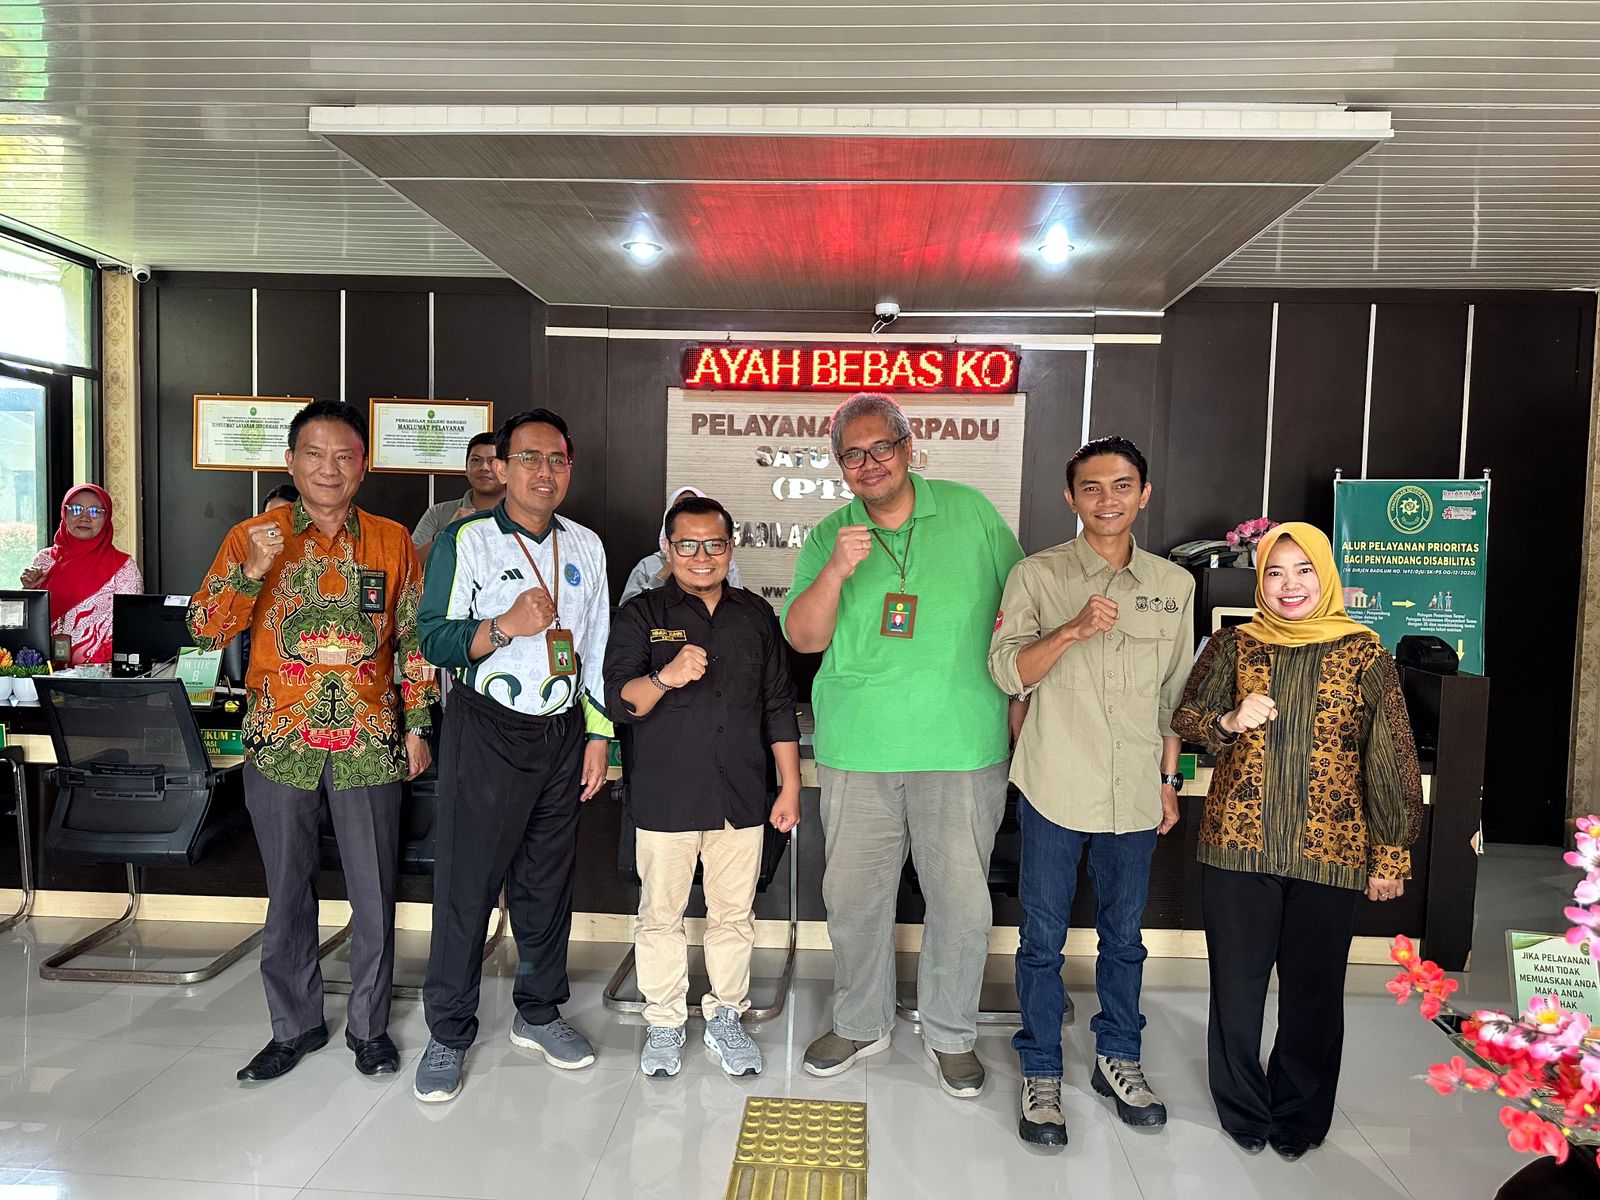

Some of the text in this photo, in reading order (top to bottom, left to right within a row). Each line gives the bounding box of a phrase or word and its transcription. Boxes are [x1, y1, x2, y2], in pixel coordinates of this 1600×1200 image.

[685, 348, 1014, 388] AYAH BEBAS KO
[691, 413, 1000, 441] PELAYANA RPADU
[756, 445, 830, 469] SATU
[1342, 542, 1480, 553] ALUR PELAYANAN PRIORITAS
[1344, 555, 1476, 567] BAGI PENYANDANG DISABILITAS
[202, 731, 228, 740] UKUM
[1521, 952, 1590, 965] JIKA PELAYANAN
[1533, 964, 1580, 976] KAMI TIDAK
[1519, 973, 1598, 989] MEMUASKAN ANDA
[1534, 986, 1584, 999] MAKA ANDA
